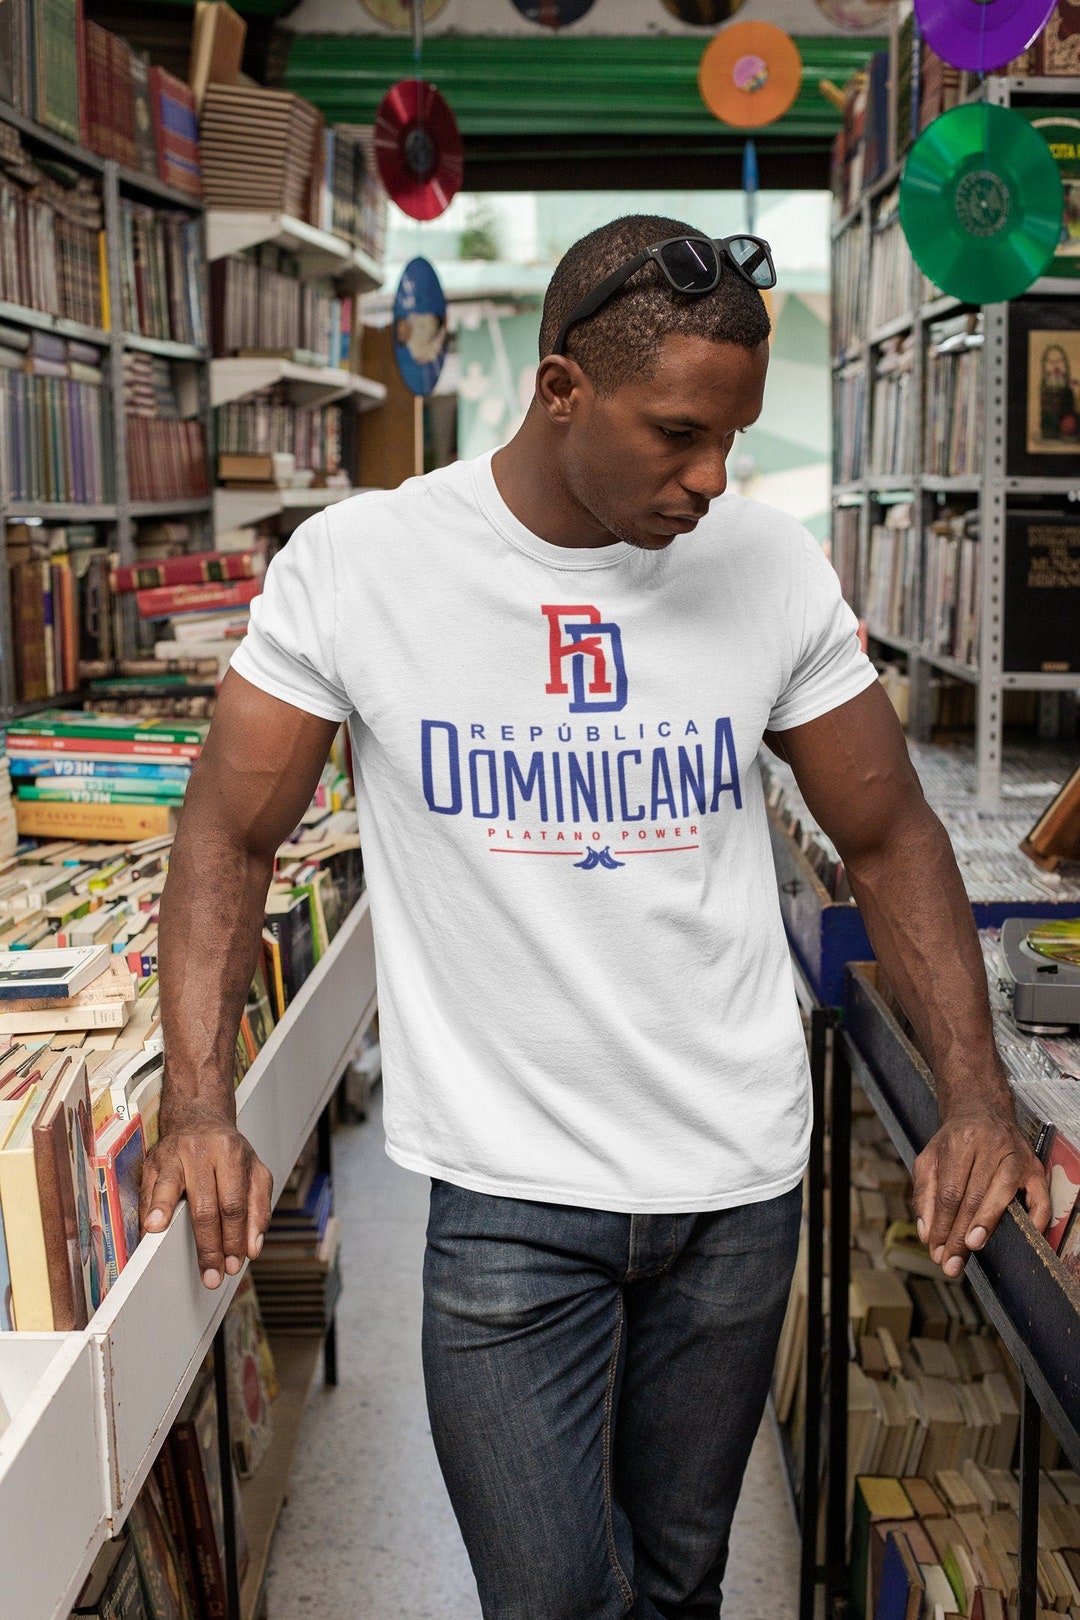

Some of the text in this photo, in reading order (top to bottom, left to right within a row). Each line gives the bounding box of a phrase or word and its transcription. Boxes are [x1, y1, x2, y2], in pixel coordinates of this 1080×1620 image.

[470, 719, 699, 742] REPÚBLICA
[421, 717, 743, 823] DOMINICANA
[487, 825, 698, 841] PLATANO POWER
